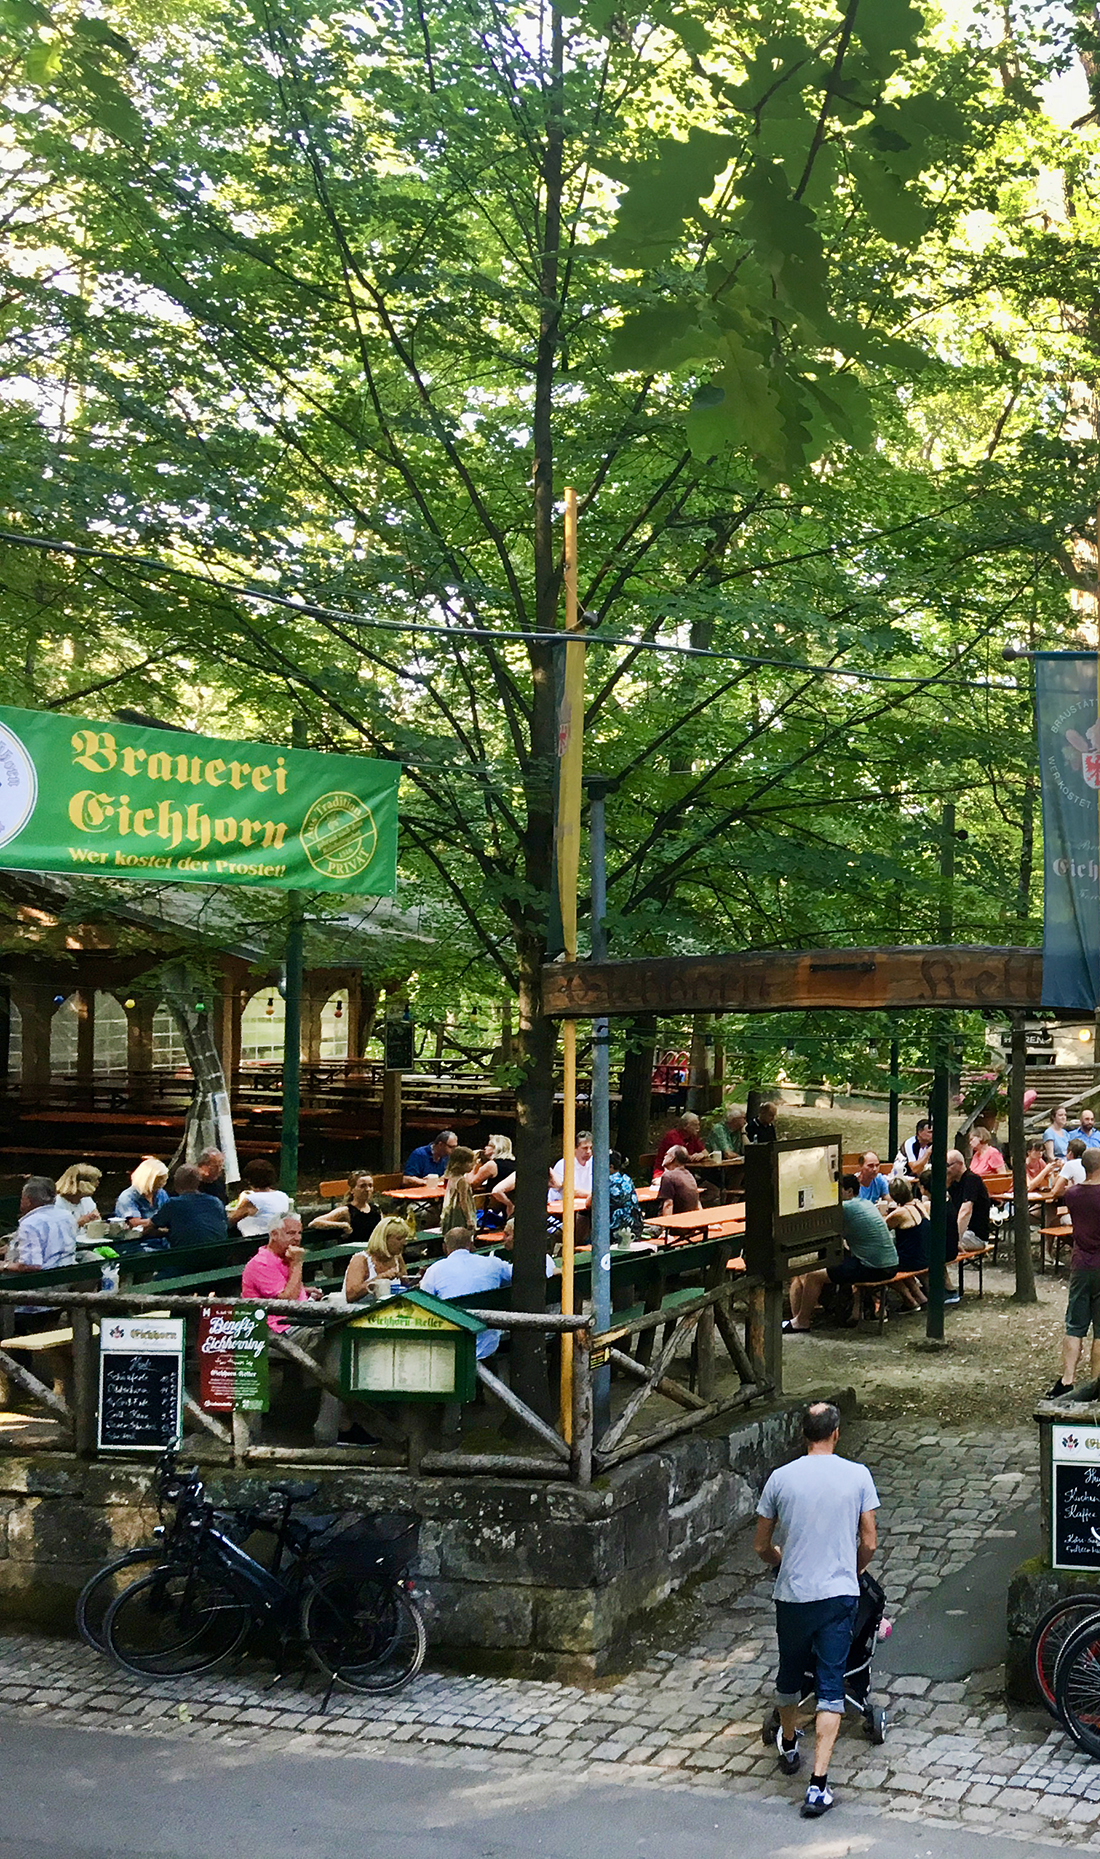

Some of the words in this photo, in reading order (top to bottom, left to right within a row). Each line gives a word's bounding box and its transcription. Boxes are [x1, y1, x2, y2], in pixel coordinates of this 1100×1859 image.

[71, 730, 288, 795] Brauerei
[68, 790, 288, 853] Eichhorn
[68, 847, 109, 865] Wer
[115, 850, 172, 869] kostet
[177, 856, 210, 872] der
[216, 860, 286, 878] Prostet!
[327, 847, 370, 874] PRIVAT
[1064, 1505, 1097, 1522] Kaffee
